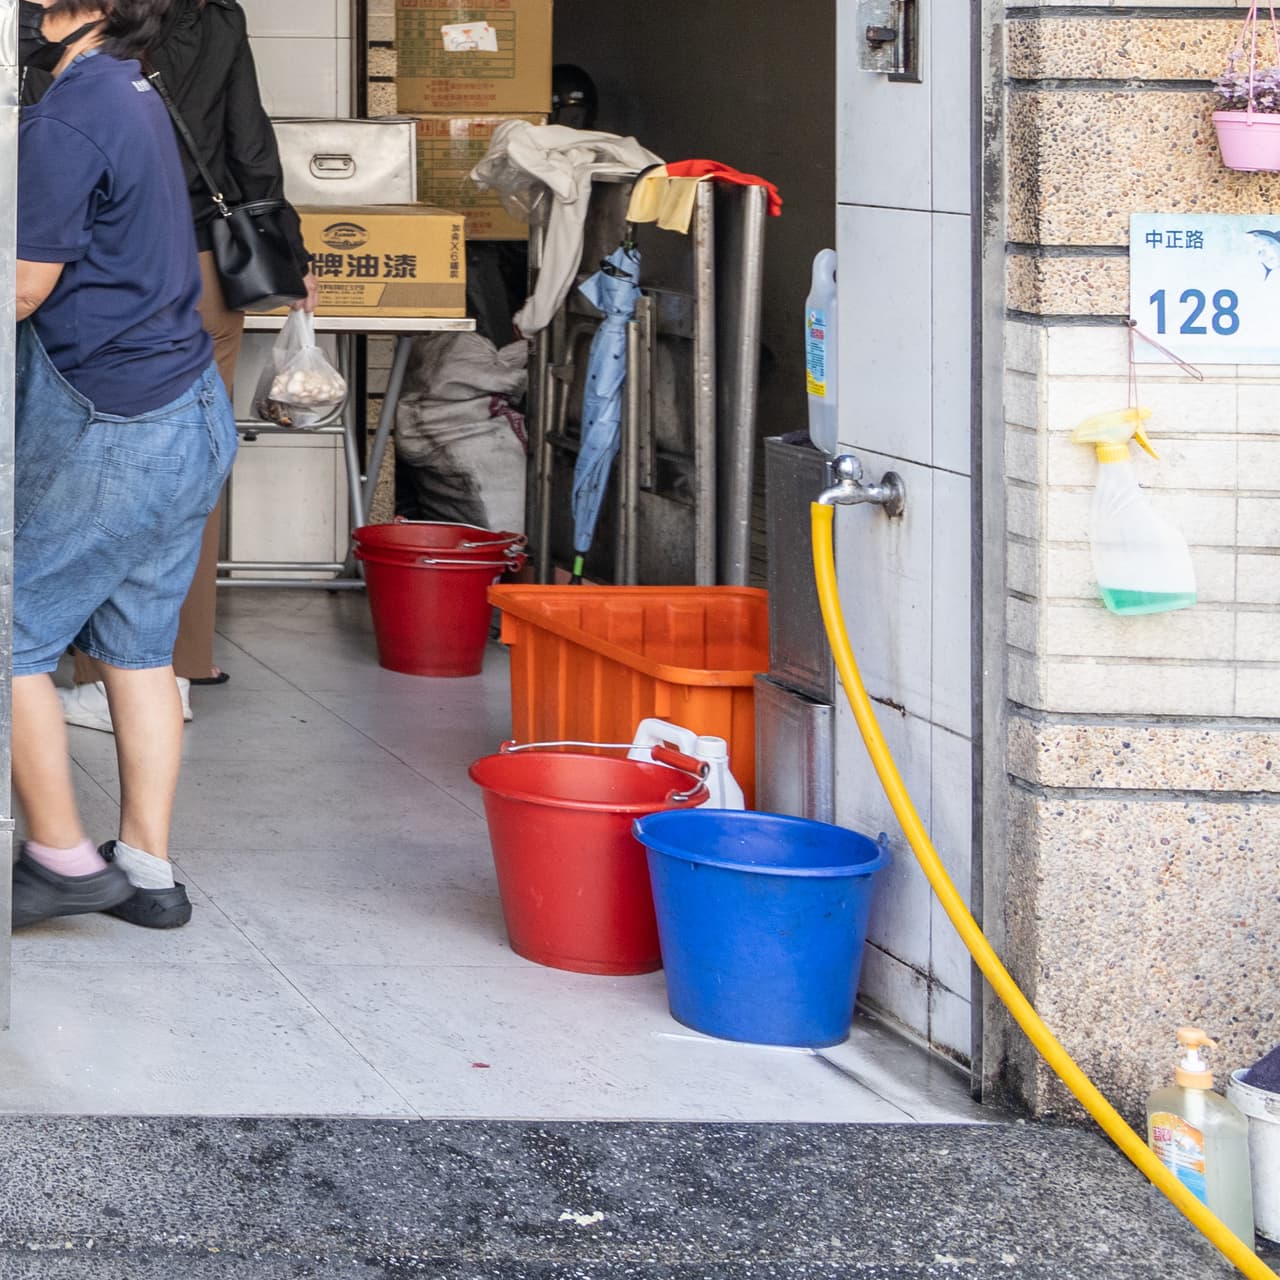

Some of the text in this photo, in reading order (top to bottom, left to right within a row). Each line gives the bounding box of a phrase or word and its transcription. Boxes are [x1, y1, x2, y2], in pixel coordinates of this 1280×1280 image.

[1145, 229, 1204, 250] 中正路
[1149, 288, 1240, 336] 128
